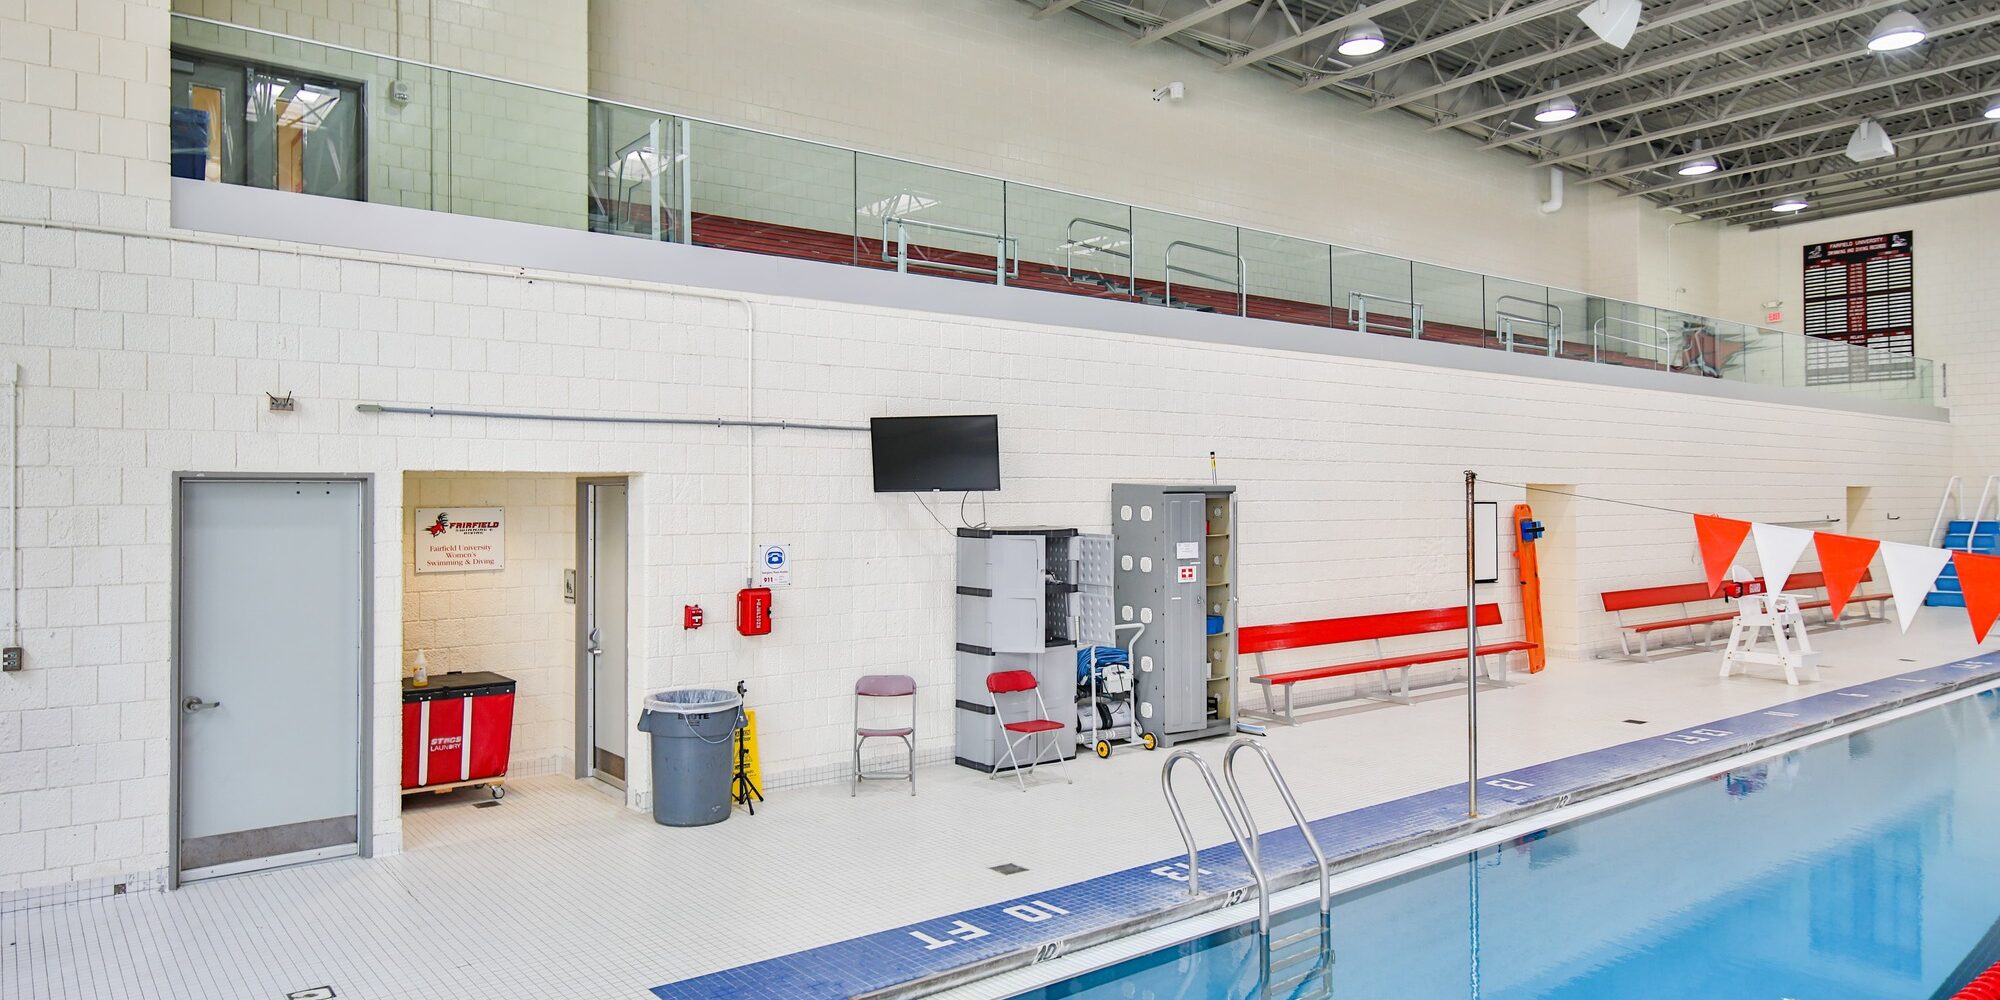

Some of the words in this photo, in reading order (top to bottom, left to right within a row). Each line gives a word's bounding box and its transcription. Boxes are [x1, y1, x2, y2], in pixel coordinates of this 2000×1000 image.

[1829, 241, 1854, 249] FAIRFIELD
[1855, 237, 1884, 246] UNIVERSITY
[458, 544, 492, 552] University
[427, 559, 463, 567] Swimming
[473, 558, 495, 566] Diving
[430, 743, 462, 752] LAUNDRY
[1485, 778, 1536, 791] 13
[1151, 862, 1213, 881] 13
[1002, 900, 1070, 922] 10
[909, 920, 991, 951] FT
